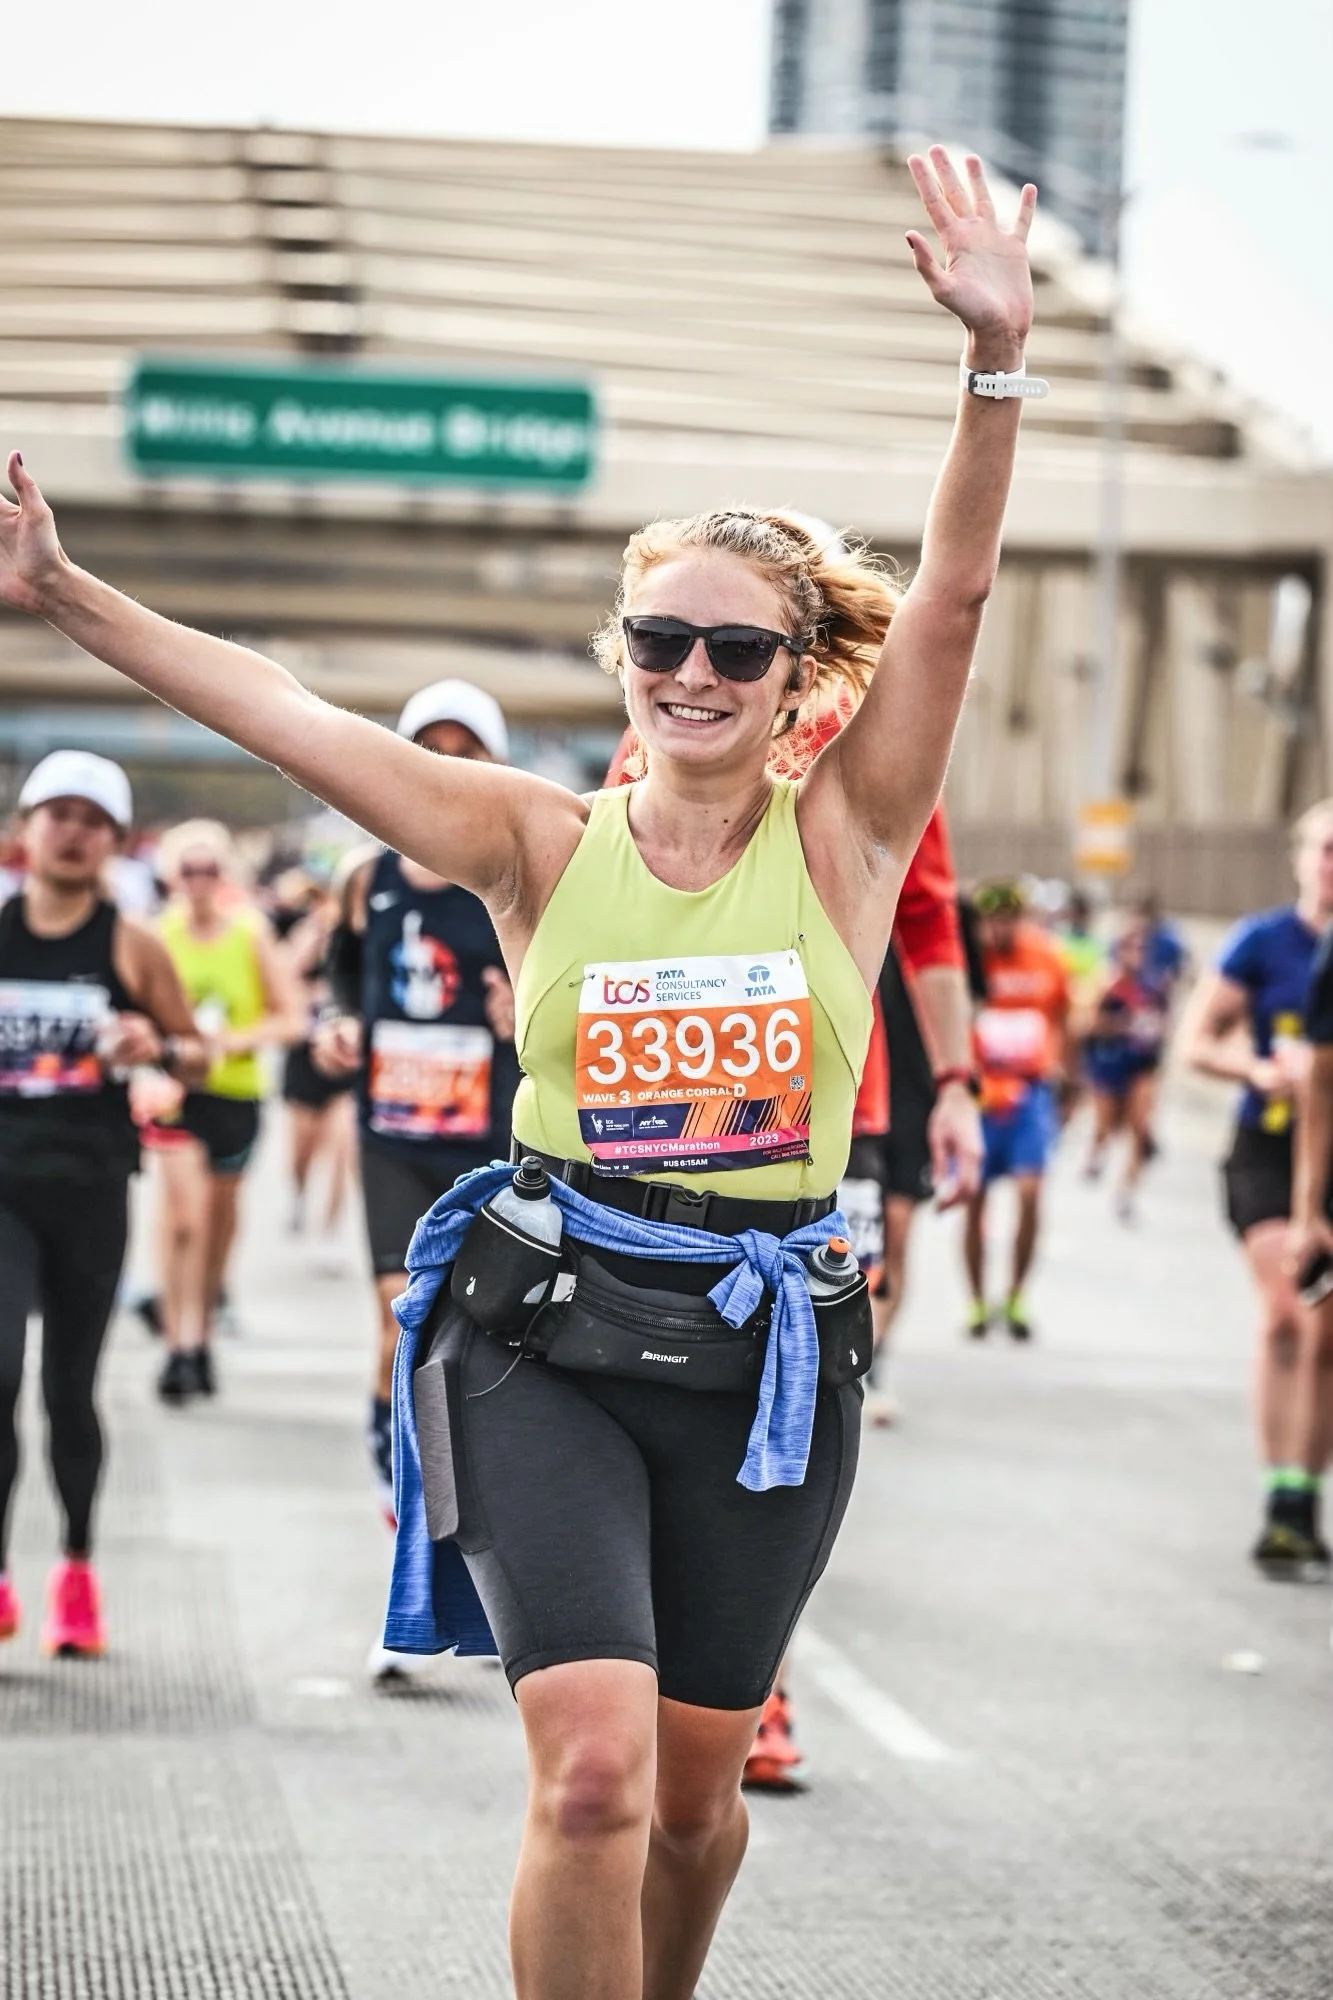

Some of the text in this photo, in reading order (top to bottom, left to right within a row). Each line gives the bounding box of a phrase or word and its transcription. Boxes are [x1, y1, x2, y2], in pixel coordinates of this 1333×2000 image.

[656, 969, 685, 979] TATA
[603, 975, 650, 1005] tcs
[655, 978, 727, 990] CONSULTANCY
[656, 991, 702, 1002] SERVICES
[744, 985, 777, 997] TATA
[587, 1008, 801, 1085] 33936
[583, 1083, 746, 1104] WAVE 3 ORANGE CORRAL D
[615, 1134, 779, 1154] #TCSNYCMarathon 2023
[680, 1159, 708, 1167] 6:15AM
[641, 1350, 689, 1364] BRINGIT
